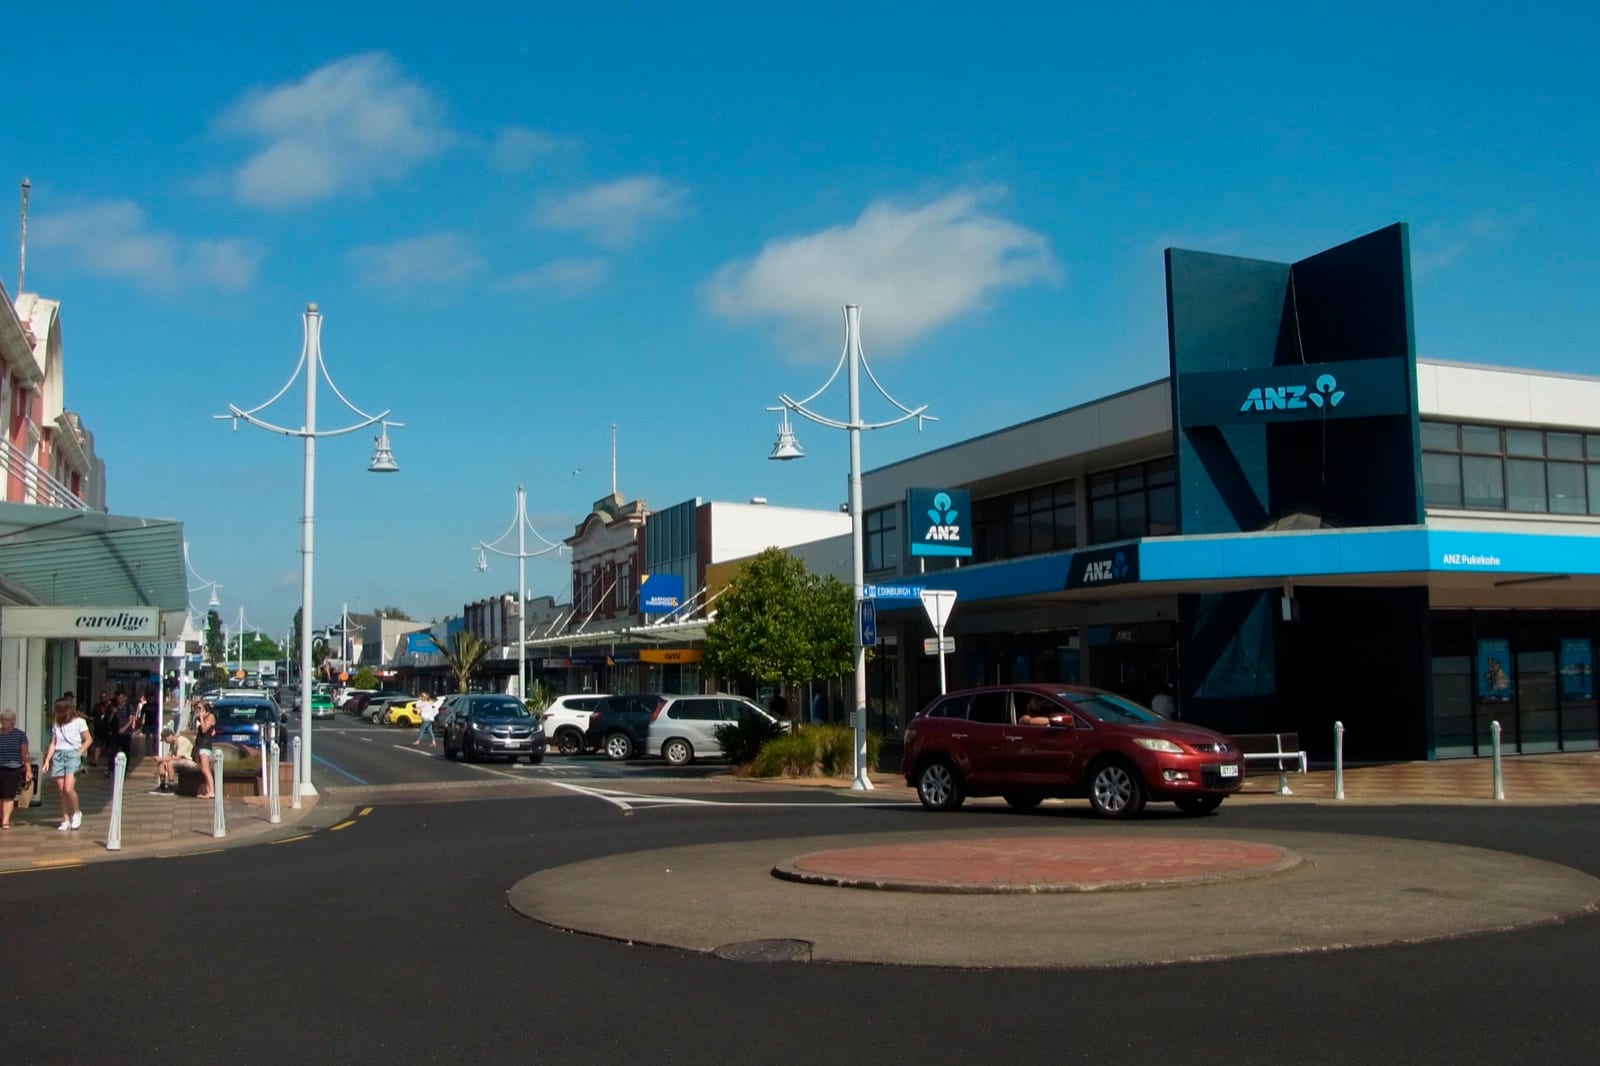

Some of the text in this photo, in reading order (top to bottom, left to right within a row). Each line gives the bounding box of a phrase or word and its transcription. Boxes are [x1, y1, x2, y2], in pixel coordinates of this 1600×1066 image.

[1240, 385, 1307, 411] ANZ
[925, 525, 960, 540] ANZ
[1443, 553, 1501, 566] ANZ Pukekohe
[1083, 560, 1113, 582] ANZ
[877, 586, 911, 597] EDINBURGH
[75, 612, 149, 628] caroline
[1115, 631, 1132, 640] ANZ
